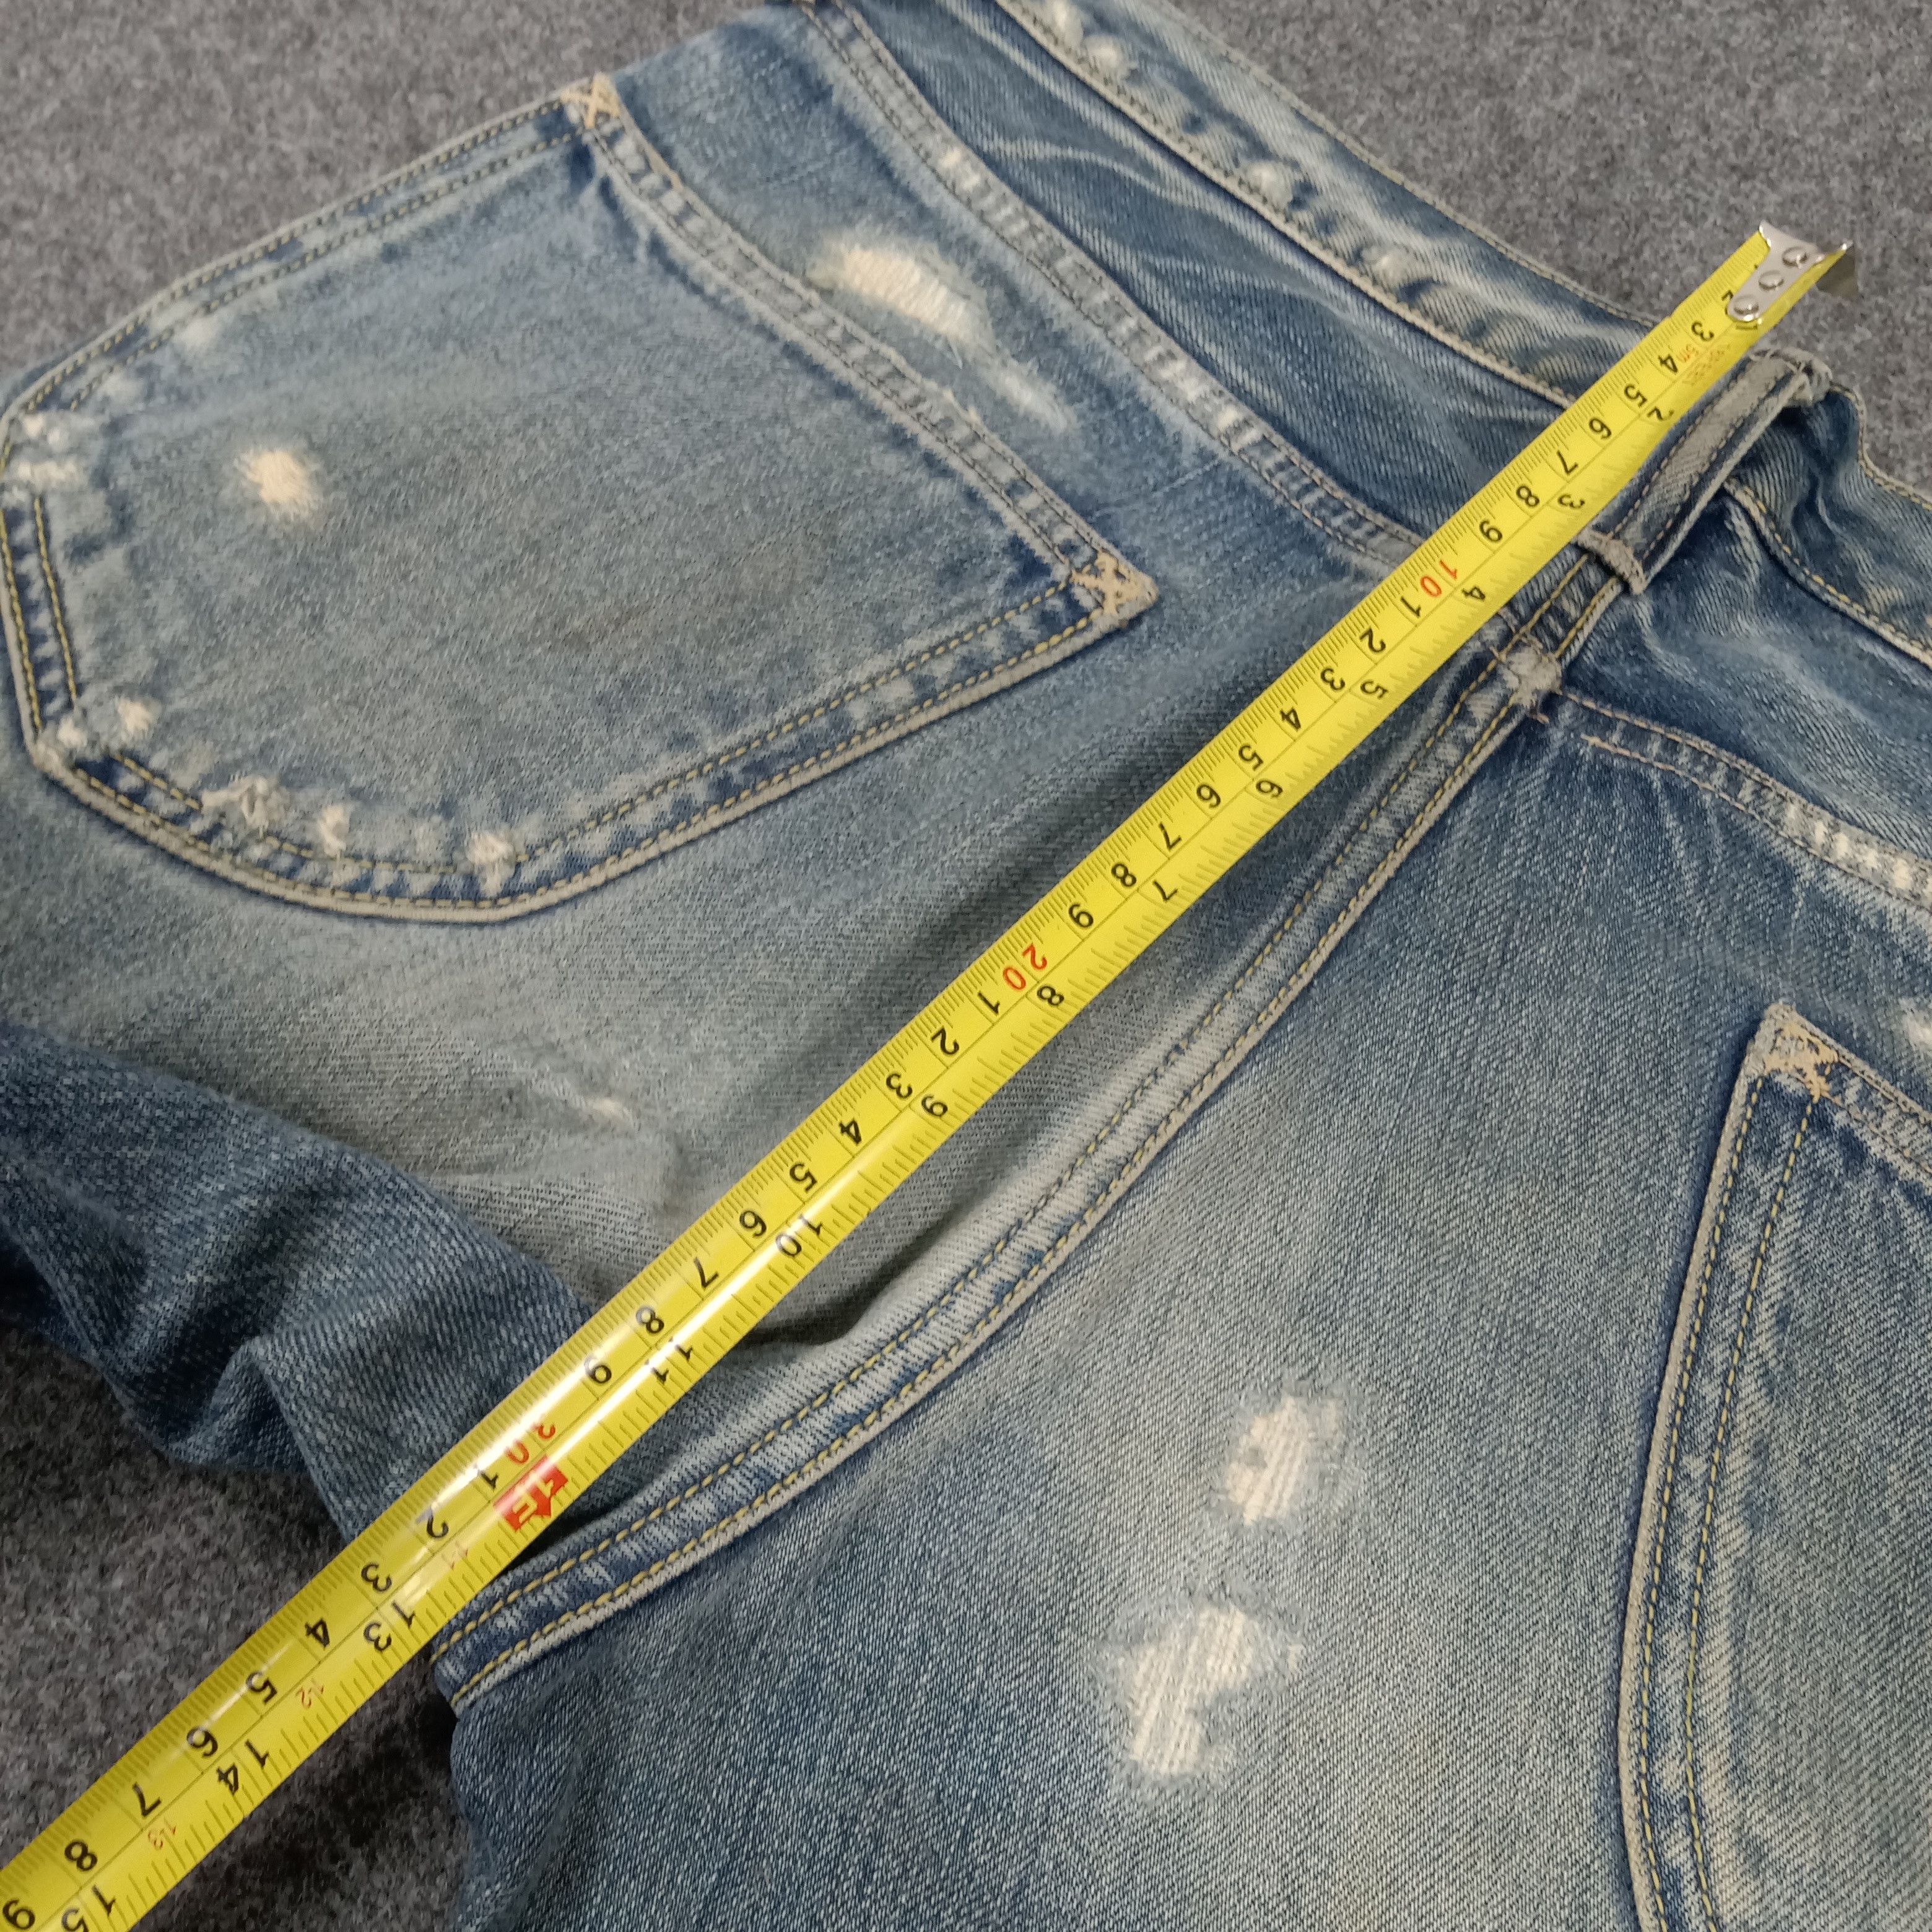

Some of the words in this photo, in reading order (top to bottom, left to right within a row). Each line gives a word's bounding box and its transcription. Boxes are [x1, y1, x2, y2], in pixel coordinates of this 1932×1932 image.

[1690, 321, 1714, 341] 3
[1658, 354, 1677, 373] 4
[1624, 384, 1647, 407] 5
[1647, 406, 1674, 421] 2
[1588, 417, 1611, 438] 6
[1556, 450, 1578, 475] 7
[1515, 484, 1540, 507] 8
[1557, 494, 1585, 508] 3
[1479, 520, 1502, 542] 9
[1419, 559, 1457, 597] 10
[1461, 586, 1486, 601] 4
[1400, 596, 1421, 618] 1
[1359, 627, 1386, 653] 2
[1320, 667, 1345, 690] 3
[1360, 681, 1388, 699] 5
[1279, 707, 1301, 731] 4
[1238, 744, 1263, 770] 5
[1196, 783, 1221, 808] 6
[1255, 780, 1283, 798] 6
[1158, 822, 1181, 851] 7
[1110, 862, 1136, 887] 8
[1152, 880, 1178, 903] 7
[1068, 903, 1094, 928] 9
[1002, 942, 1047, 990] 20
[977, 991, 1000, 1014] 1
[1036, 985, 1064, 1007] 8
[930, 1025, 959, 1055] 2
[886, 1073, 913, 1099] 3
[921, 1095, 947, 1118] 9
[838, 1118, 862, 1145] 4
[789, 1162, 817, 1193] 5
[739, 1209, 767, 1237] 6
[776, 1214, 823, 1259] 10
[693, 1257, 719, 1289] 7
[636, 1305, 664, 1334] 8
[584, 1356, 612, 1385] 9
[472, 1463, 498, 1490] 1
[511, 1468, 552, 1525] 1F
[416, 1506, 448, 1538] 2
[360, 1562, 392, 1592] 3
[304, 1618, 329, 1648] 4
[363, 1602, 416, 1653] 13
[245, 1671, 277, 1705] 5
[186, 1727, 218, 1757] 6
[215, 1739, 269, 1796] 14
[132, 1782, 161, 1817] 7
[64, 1840, 97, 1871] 8
[2, 1899, 35, 1930] 9
